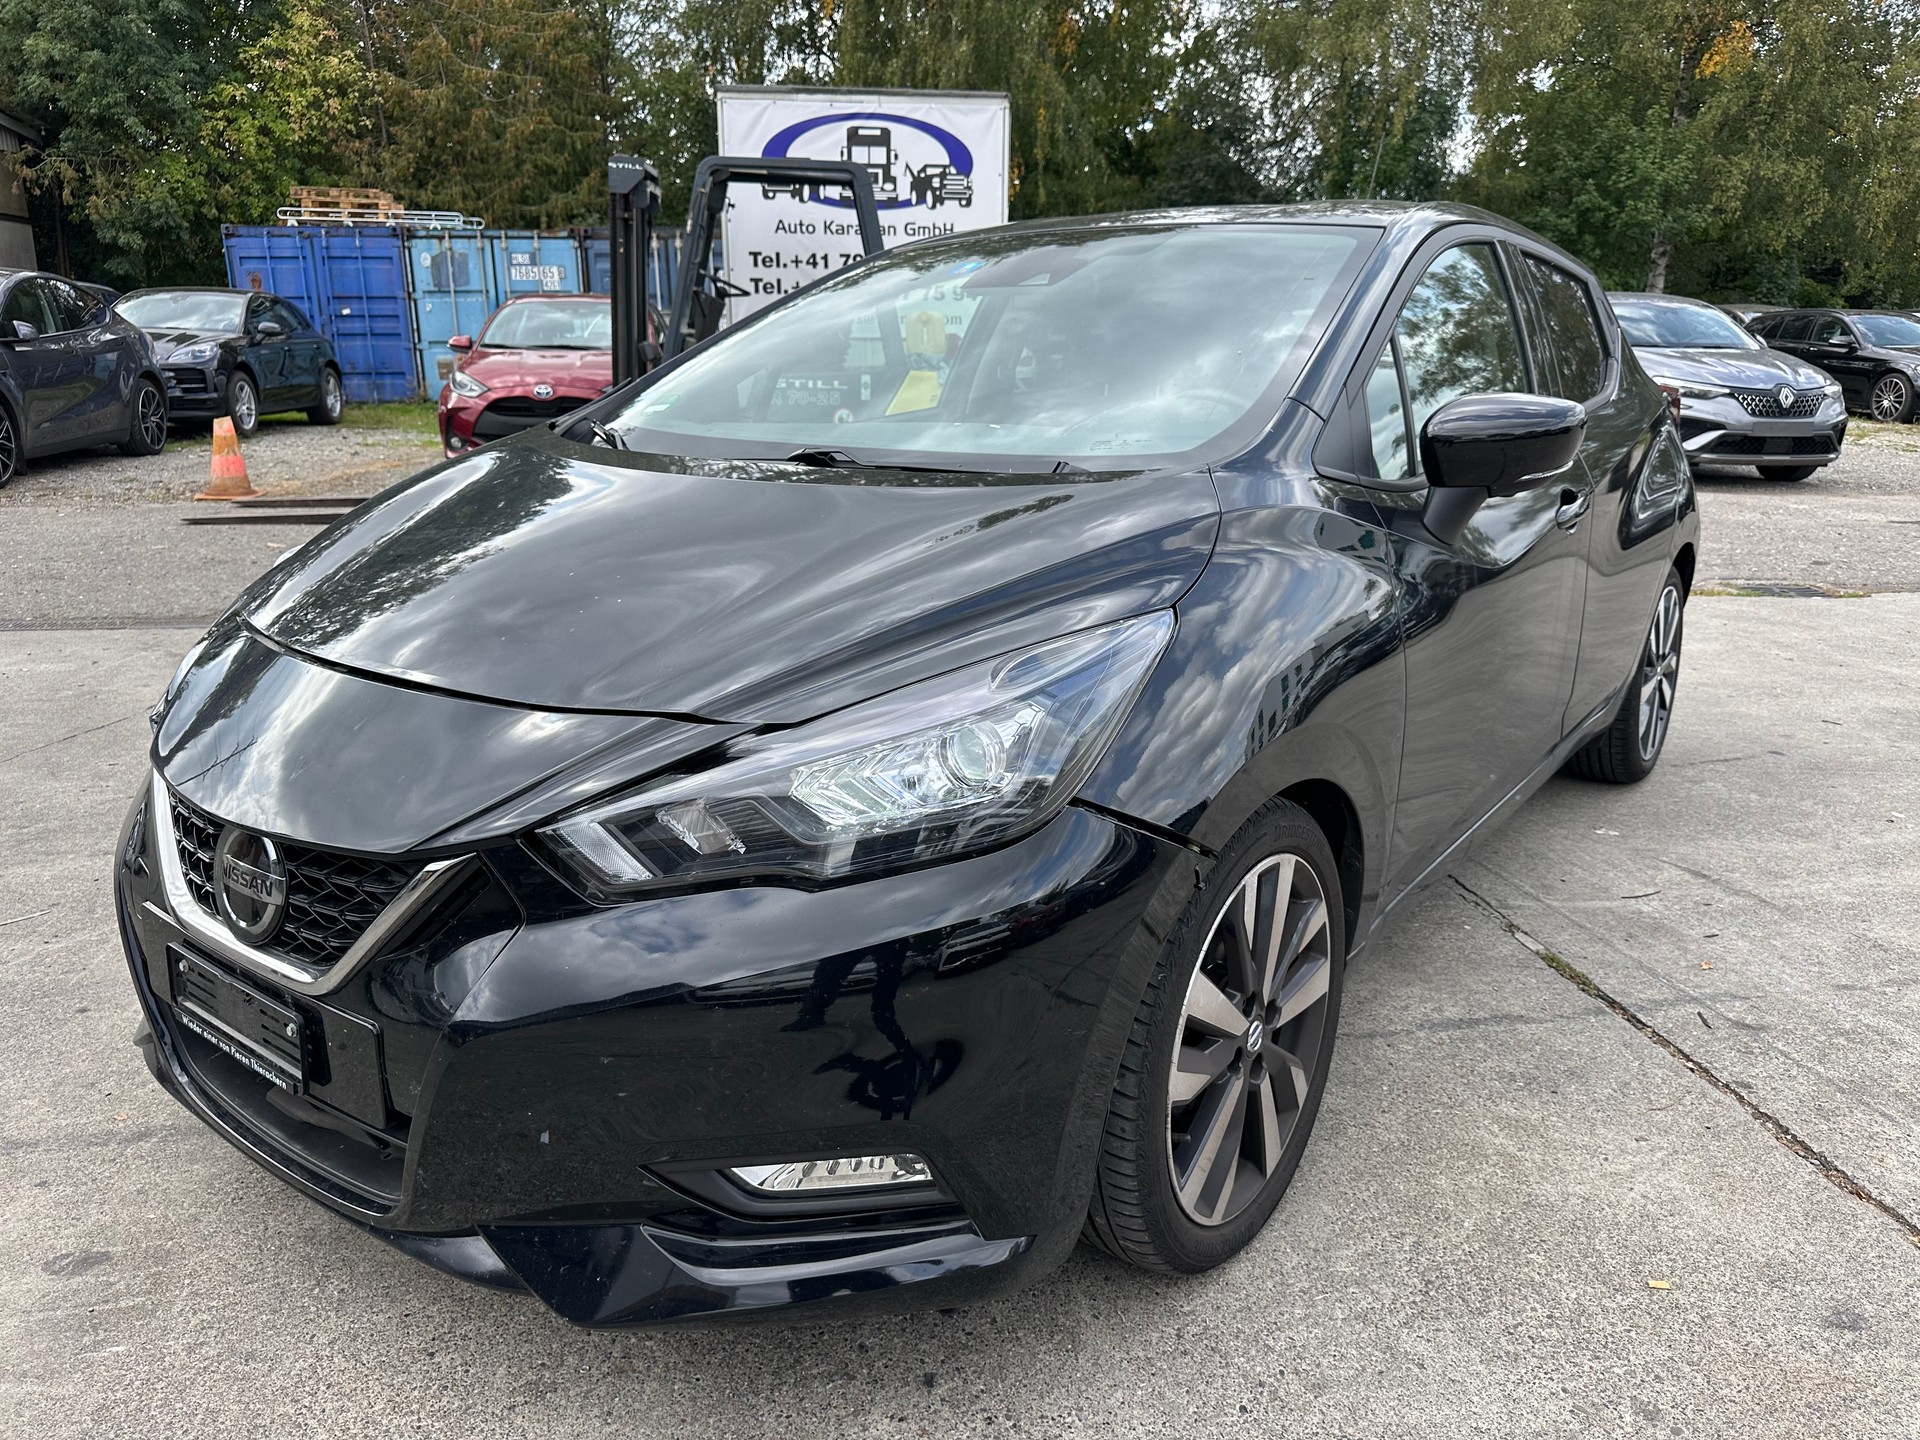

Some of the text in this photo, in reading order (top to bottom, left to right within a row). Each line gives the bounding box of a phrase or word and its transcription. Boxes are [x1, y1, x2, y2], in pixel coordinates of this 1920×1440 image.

[775, 219, 954, 237] Auto Karaan GmbH
[749, 251, 830, 269] Tel.+41
[222, 861, 274, 898] NISSAN
[181, 1013, 203, 1035] Wieder
[203, 1030, 218, 1046] einer
[219, 1041, 230, 1053] von
